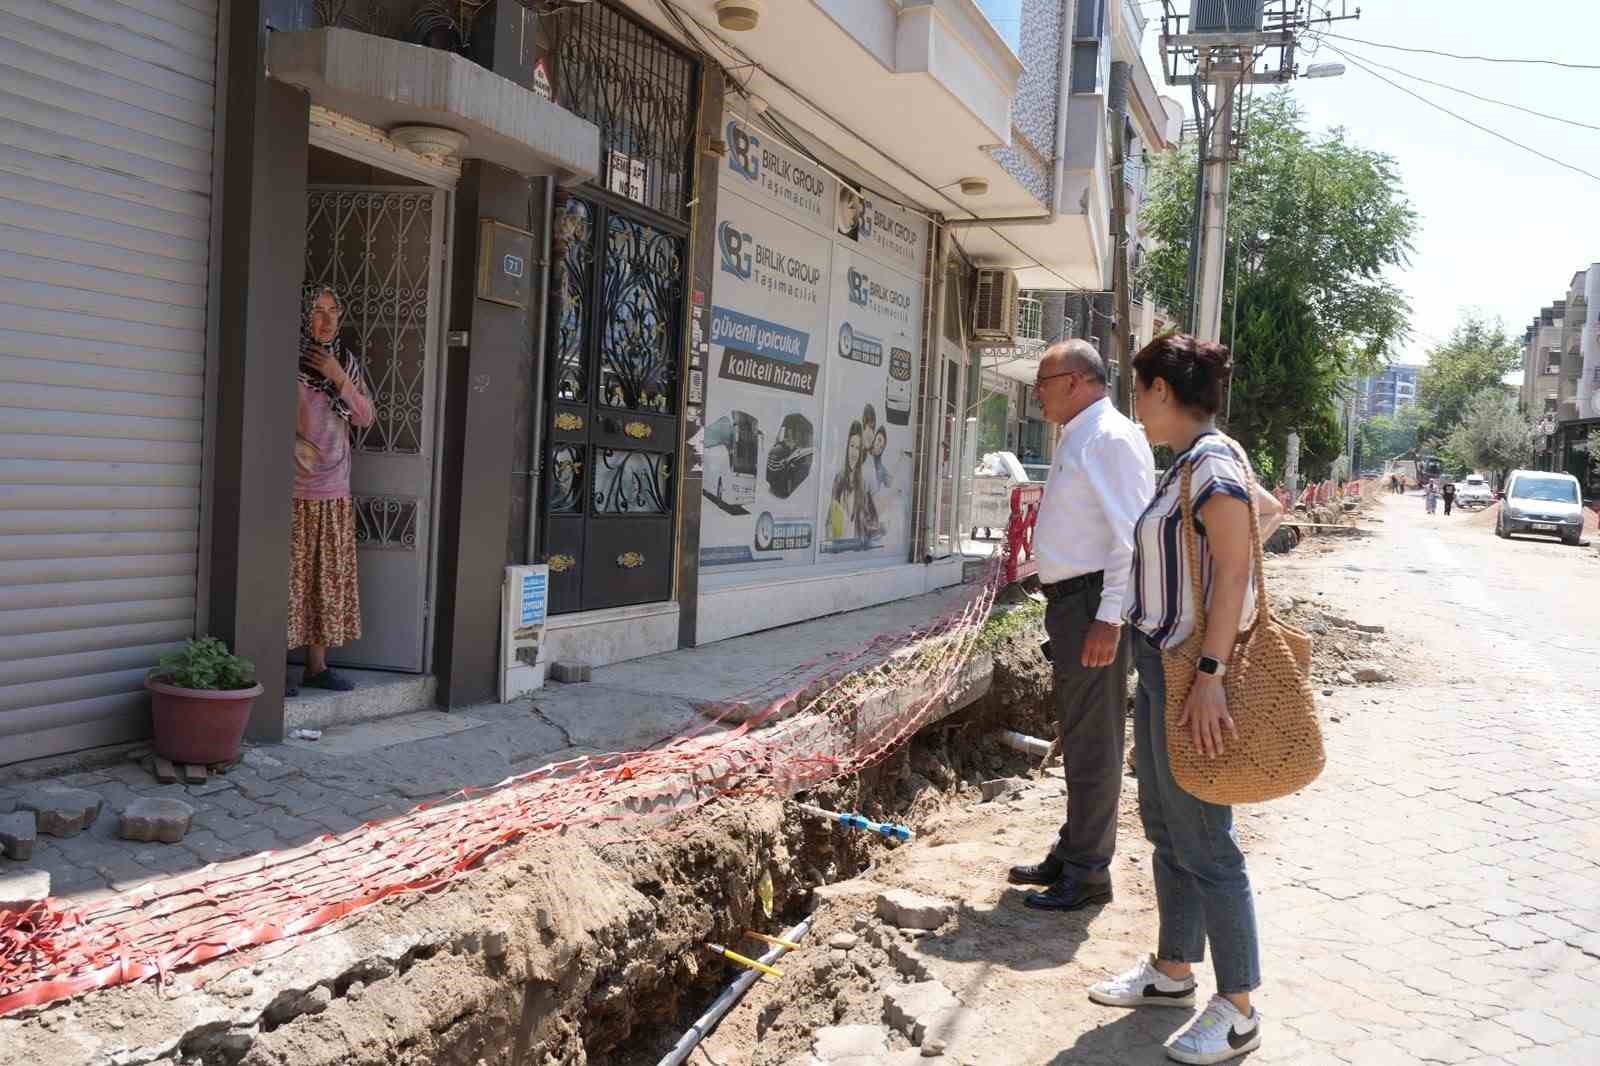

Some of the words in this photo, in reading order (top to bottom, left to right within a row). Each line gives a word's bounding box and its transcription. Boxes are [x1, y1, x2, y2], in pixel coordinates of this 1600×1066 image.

[793, 169, 824, 197] GROUP
[895, 221, 917, 245] GROUP
[787, 259, 820, 285] GROUP
[889, 289, 911, 310] GROUP
[711, 317, 757, 345] güvenli
[757, 326, 801, 356] yolculuk
[728, 355, 773, 381] kaliteli
[774, 362, 813, 391] hizmet
